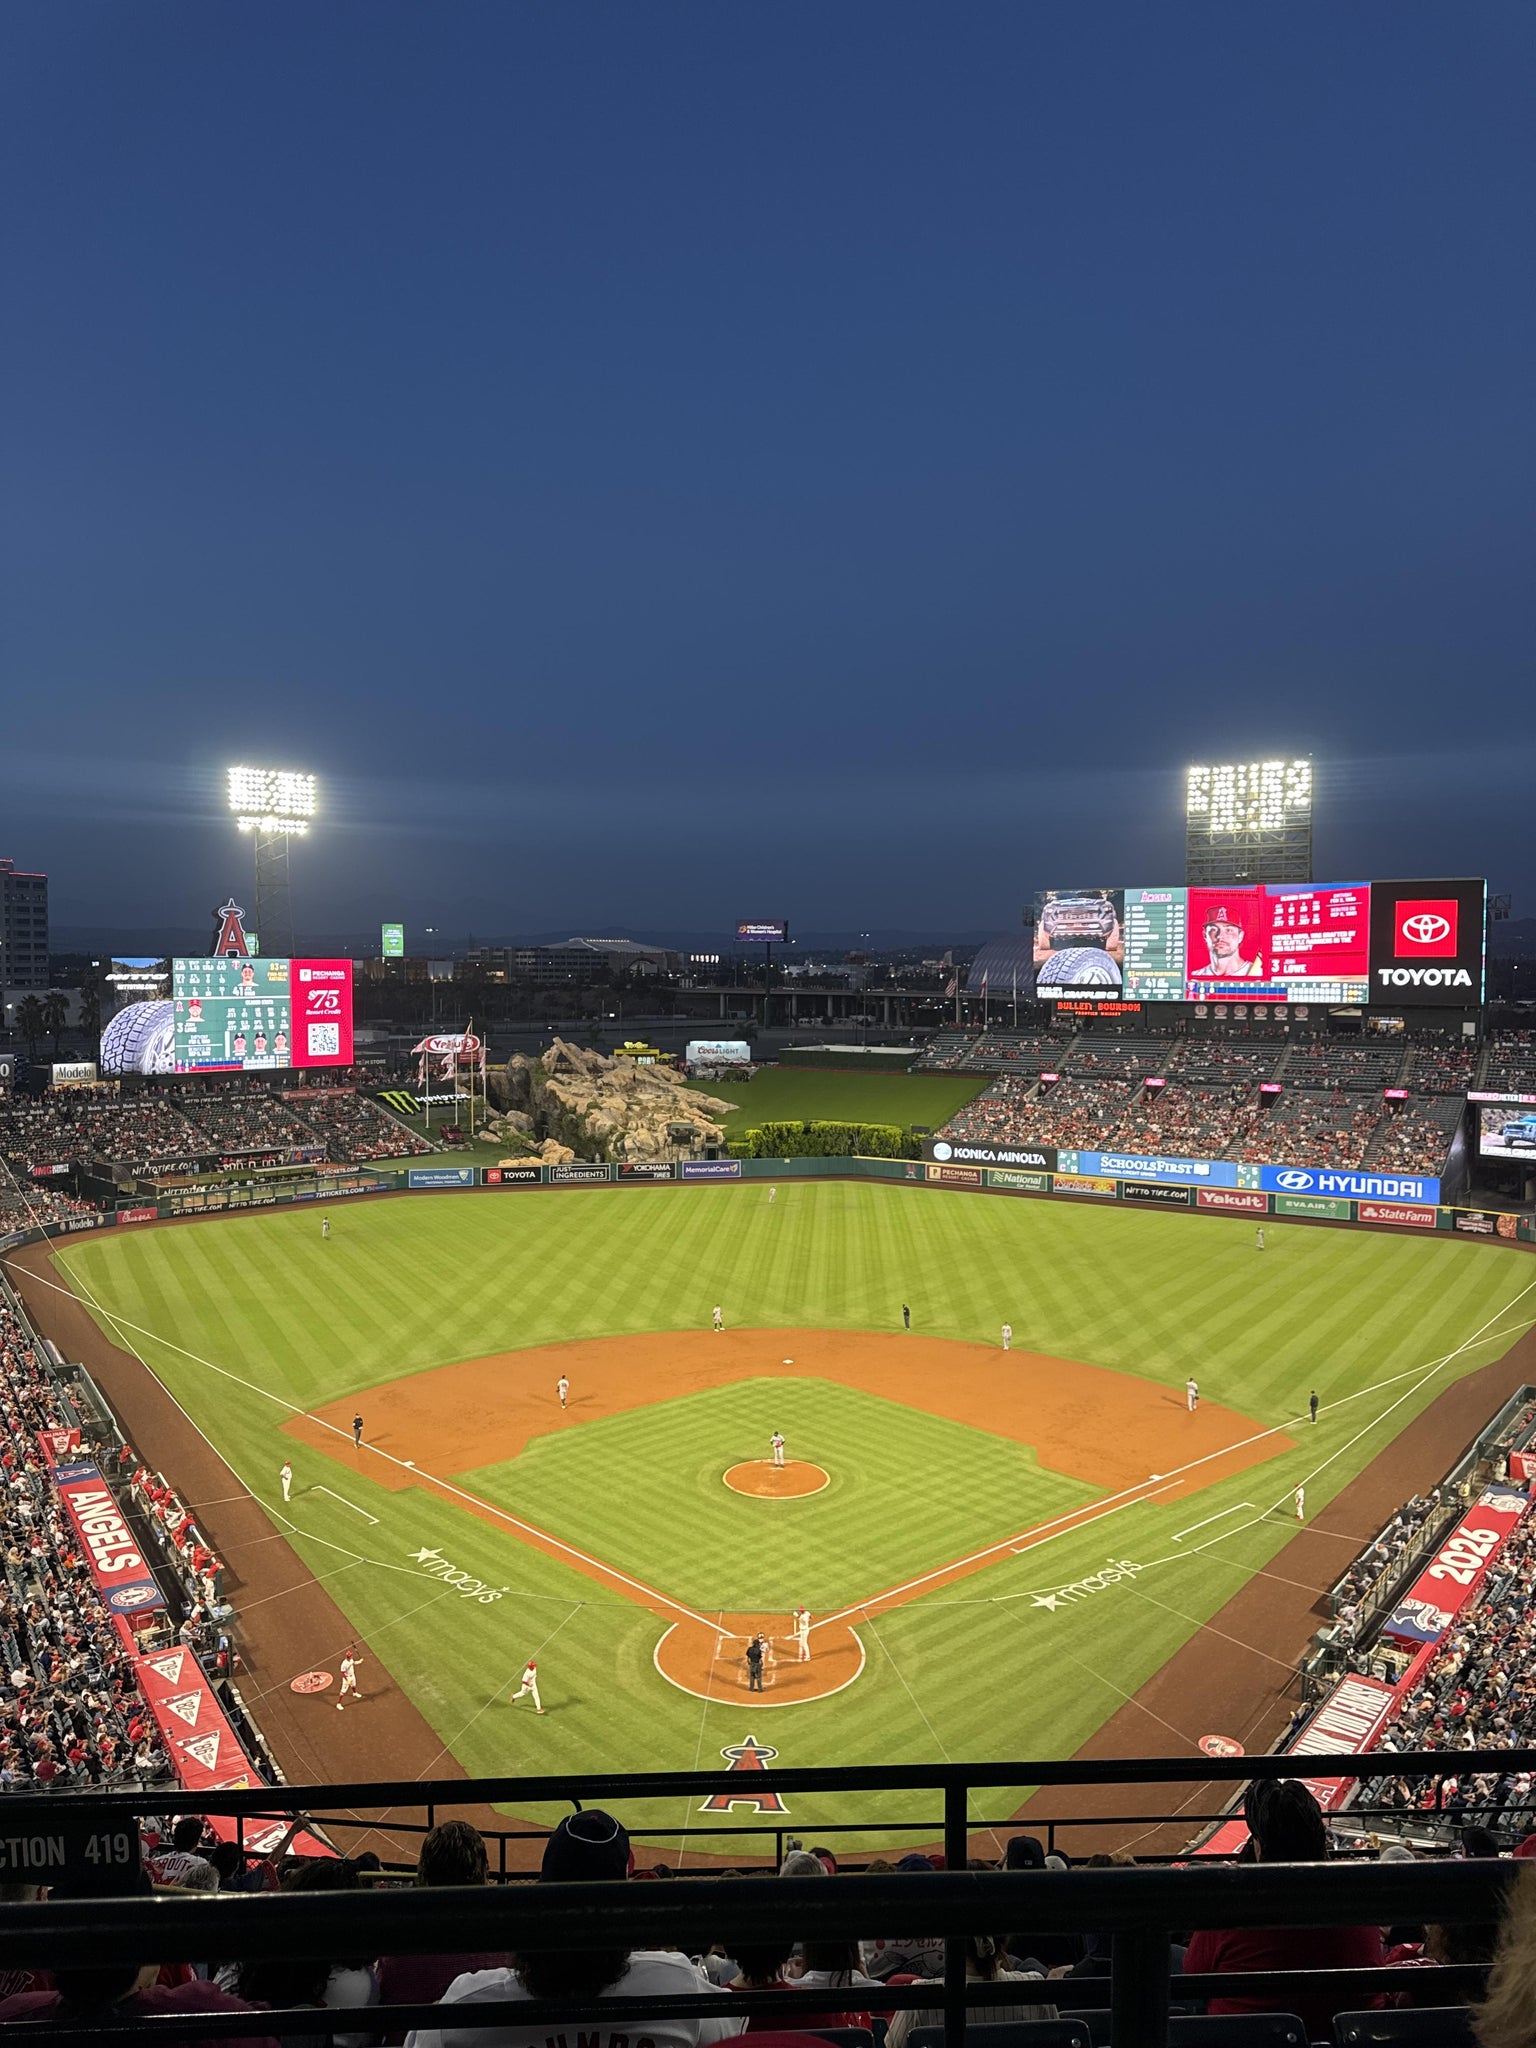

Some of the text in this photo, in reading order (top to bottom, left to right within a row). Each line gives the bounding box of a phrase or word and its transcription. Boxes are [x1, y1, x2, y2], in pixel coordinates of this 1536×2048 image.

[1271, 959, 1280, 973] 3
[1378, 968, 1472, 987] TOYOTA
[232, 986, 244, 996] 41
[307, 989, 340, 1009] $75
[1098, 1002, 1140, 1012] BOURBON
[697, 1046, 718, 1055] Coors
[58, 1066, 92, 1079] Modelo
[954, 1147, 995, 1161] KONICA
[997, 1151, 1047, 1165] MINOLTA
[633, 1164, 671, 1172] YOKOHAMA
[685, 1165, 730, 1174] MemorialCare
[942, 1169, 977, 1178] PECHANGA
[504, 1171, 536, 1179] TOYOTA
[556, 1171, 604, 1179] INGREDIENTS
[1004, 1172, 1042, 1185] National
[1125, 1187, 1188, 1199] NITTO TIRE.COM
[1318, 1174, 1423, 1199] HYUNDAI
[228, 1201, 247, 1209] NITTO
[1202, 1191, 1263, 1208] Yakult
[172, 1207, 193, 1216] NITTO
[69, 1218, 94, 1231] Modelo
[68, 1491, 141, 1573] ANGELS
[1428, 1526, 1500, 1586] 2026
[1329, 1680, 1393, 1720] FANS!
[1313, 1706, 1372, 1740] YOU
[84, 1833, 130, 1865] 419
